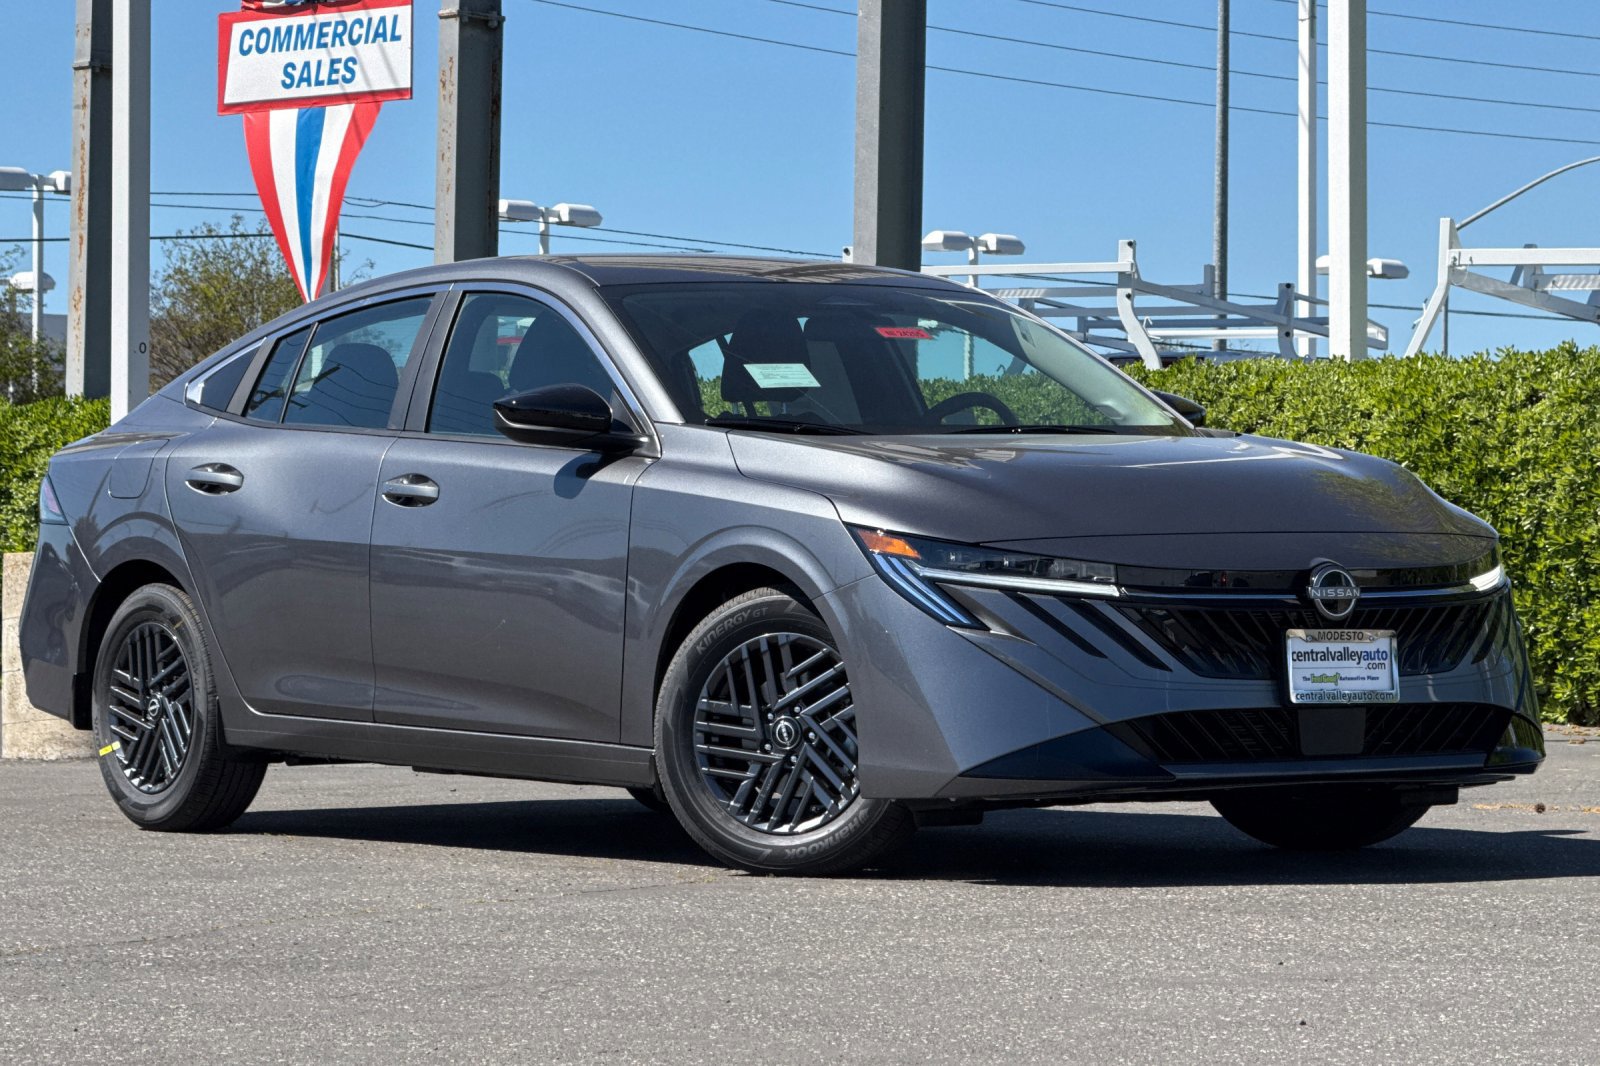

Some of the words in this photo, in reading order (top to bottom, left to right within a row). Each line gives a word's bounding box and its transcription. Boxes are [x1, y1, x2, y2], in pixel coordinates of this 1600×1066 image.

[238, 14, 402, 57] COMMERCIAL
[280, 56, 358, 90] SALES
[1311, 587, 1361, 597] NISSAN
[752, 606, 769, 618] GT
[1317, 631, 1364, 641] MODESTO
[1291, 646, 1388, 665] centralvalleyauto
[1364, 661, 1386, 671] .com
[1295, 690, 1394, 704] centralvalleyauto.com
